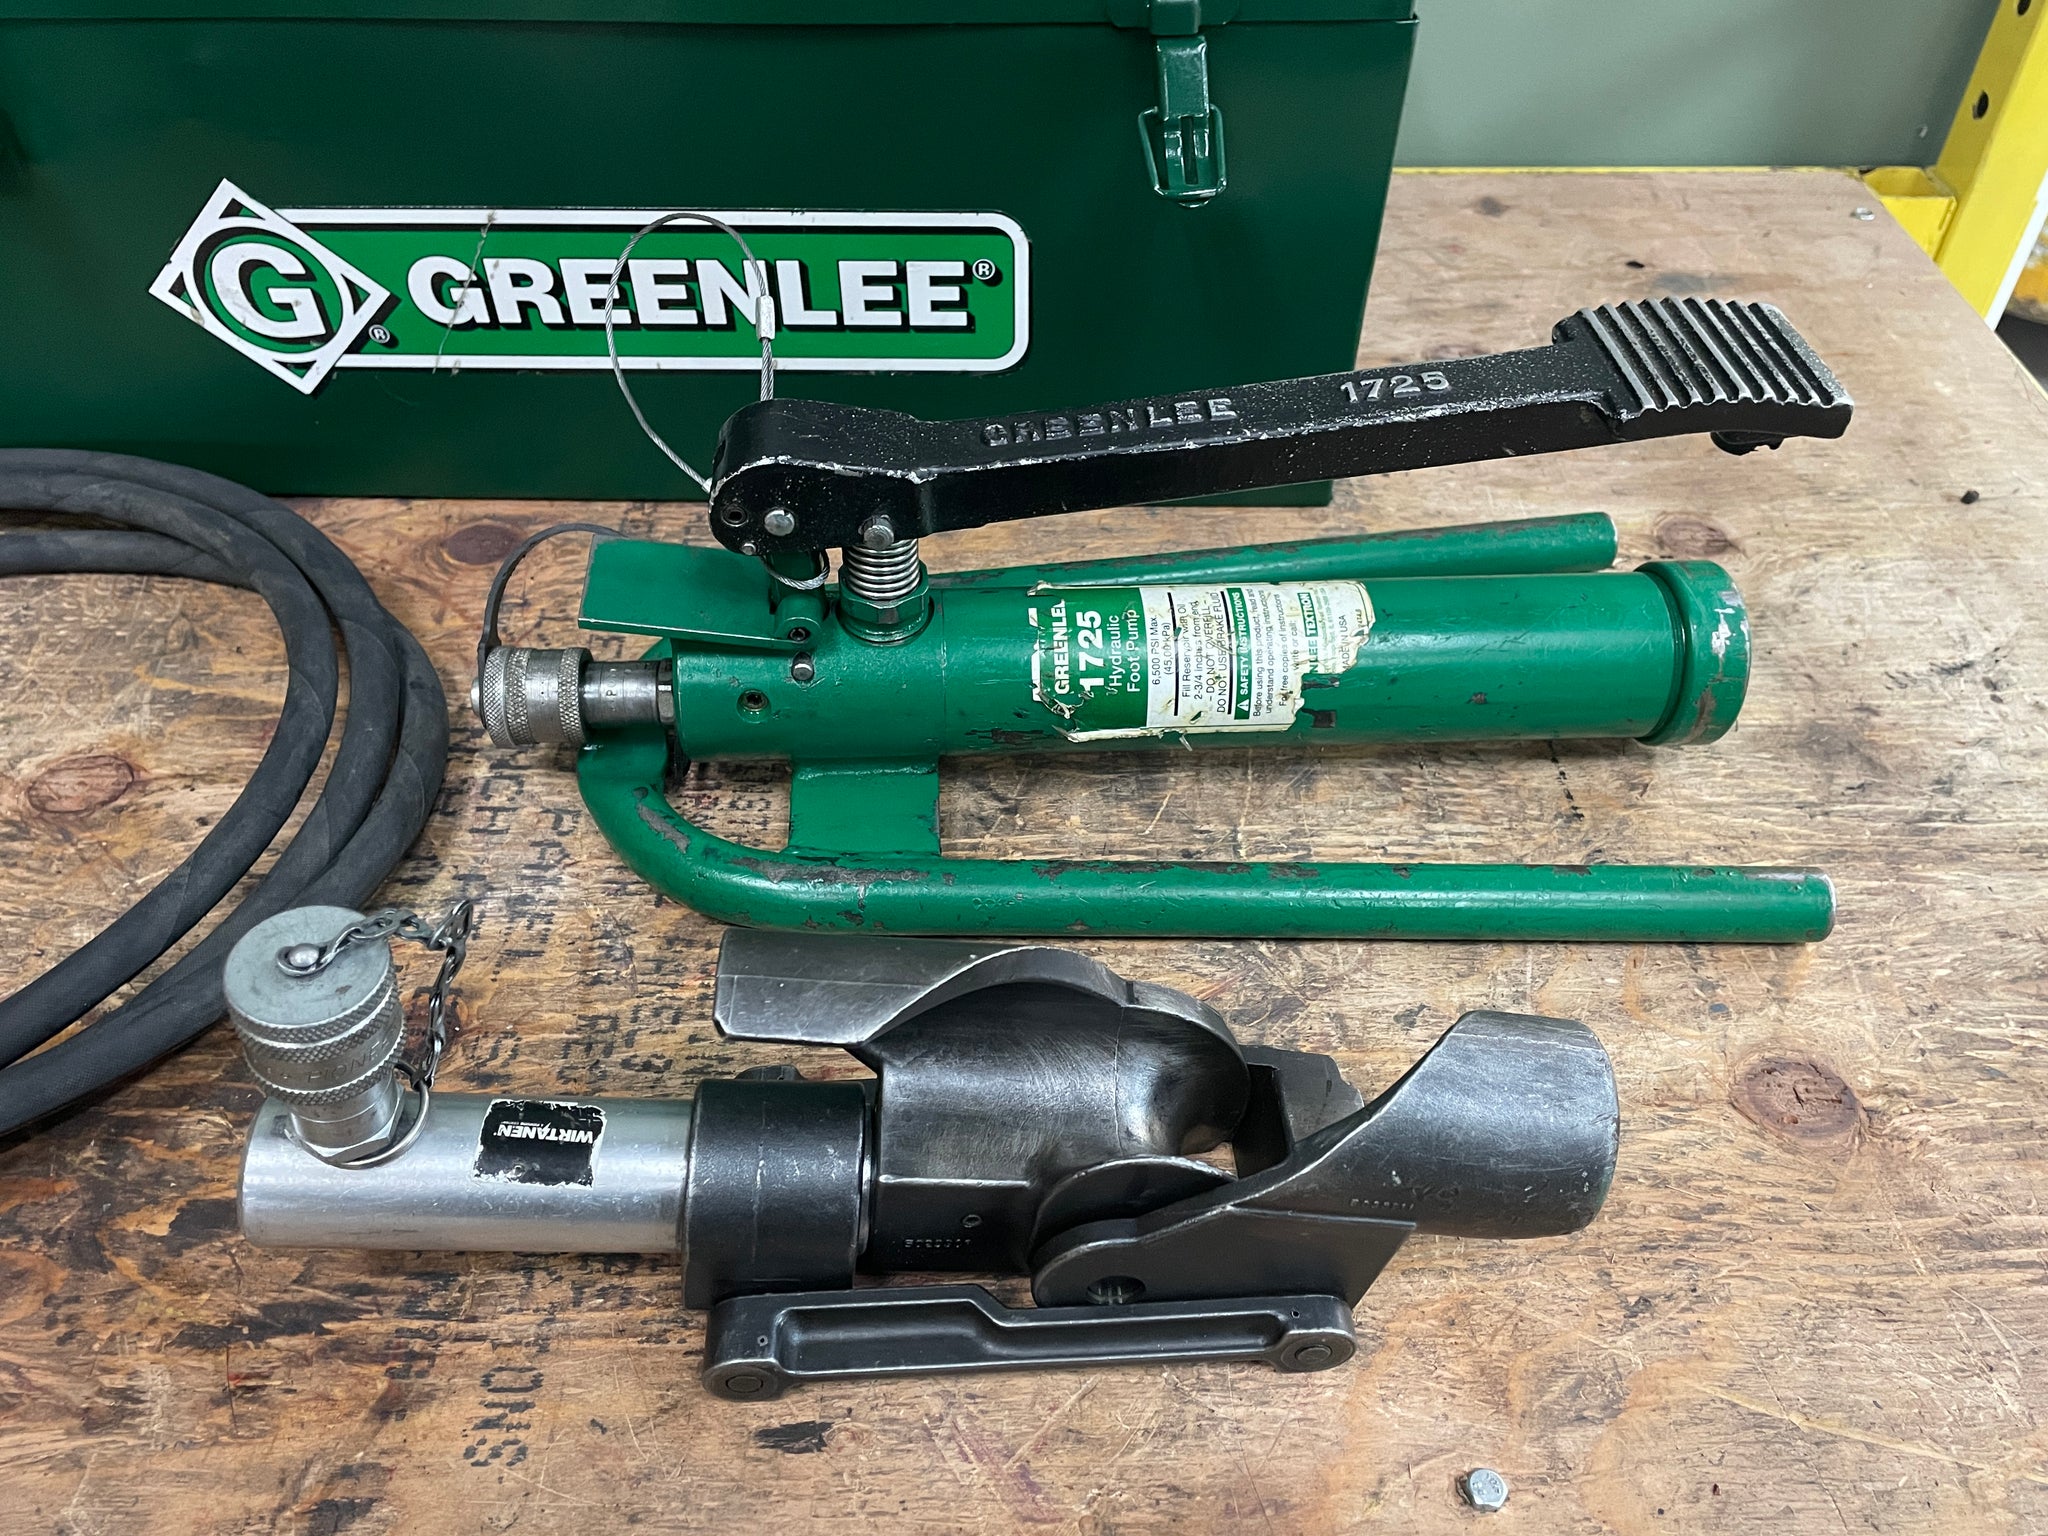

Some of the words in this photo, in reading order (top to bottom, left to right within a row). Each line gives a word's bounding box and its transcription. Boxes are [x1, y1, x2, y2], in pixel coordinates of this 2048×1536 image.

[211, 242, 326, 338] G
[1340, 371, 1449, 402] 1725
[1210, 592, 1222, 612] FLUID
[1273, 593, 1287, 632] instructions
[1299, 593, 1316, 636] TEXTRON
[1125, 609, 1142, 652] Pump
[1191, 618, 1200, 638] from
[1202, 606, 1215, 650] OVERFILL
[1231, 592, 1250, 654] INSTRUCTIONS
[1252, 614, 1264, 648] product,
[1339, 614, 1348, 632] USA
[1076, 610, 1104, 692] 1725
[1106, 615, 1125, 688] Hydraulic
[1151, 638, 1160, 656] PSI
[1265, 625, 1276, 666] operating
[1279, 633, 1288, 643] of
[1292, 638, 1300, 647] or
[1205, 653, 1216, 675] NOT
[1255, 649, 1264, 665] this
[1281, 644, 1291, 673] copies
[1126, 656, 1142, 692] Foot
[1151, 658, 1162, 686] 6,500
[1206, 677, 1216, 694] DO
[1240, 657, 1250, 696] SAFETY
[1256, 667, 1265, 690] using
[1280, 675, 1289, 691] free
[1182, 684, 1191, 698] Fill
[1194, 674, 1204, 700] 2-3/4
[1265, 668, 1274, 714] understand
[1217, 699, 1226, 714] DO
[1253, 691, 1263, 718] Before
